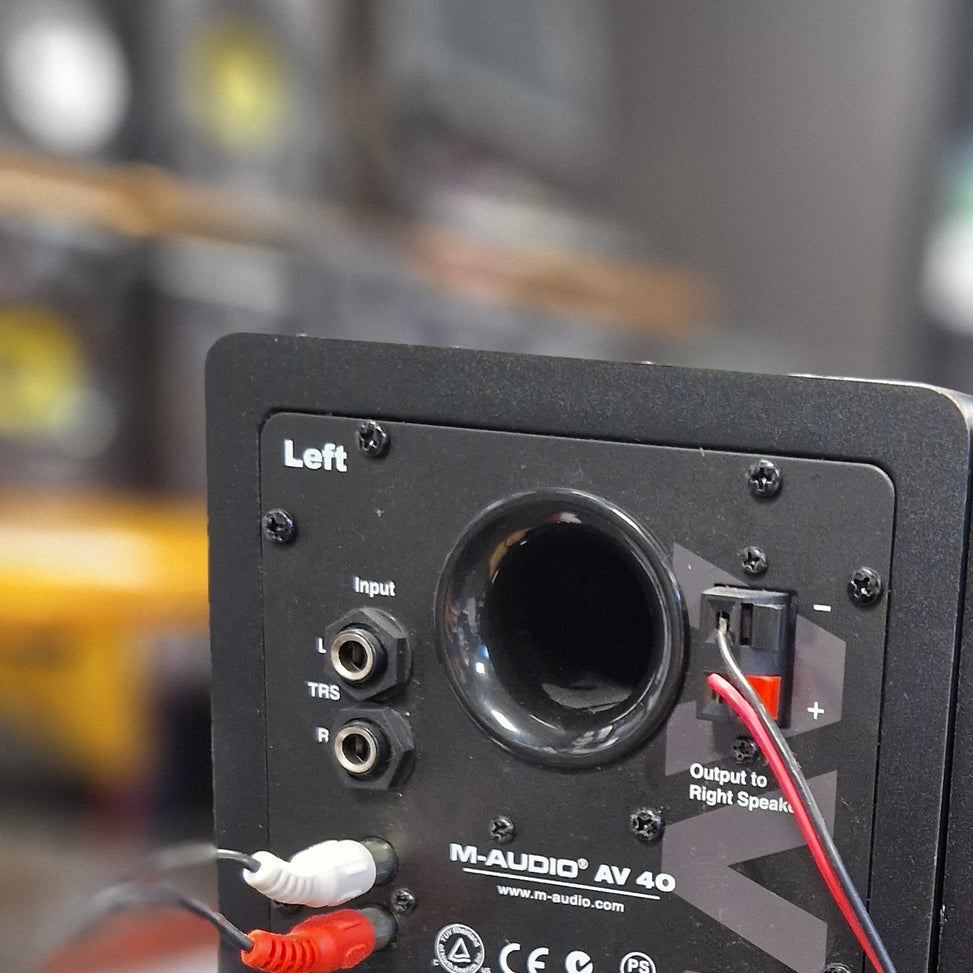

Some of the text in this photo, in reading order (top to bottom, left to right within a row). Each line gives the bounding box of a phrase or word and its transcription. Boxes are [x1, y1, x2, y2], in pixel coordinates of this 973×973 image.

[284, 439, 348, 472] Left
[354, 576, 396, 598] Input
[317, 637, 327, 654] L
[306, 681, 341, 701] TRS
[317, 727, 330, 743] R
[690, 762, 768, 788] Output to
[689, 784, 734, 807] Right
[594, 863, 632, 886] AV
[636, 869, 677, 893] 40
[496, 883, 625, 913] www.m-audio.com
